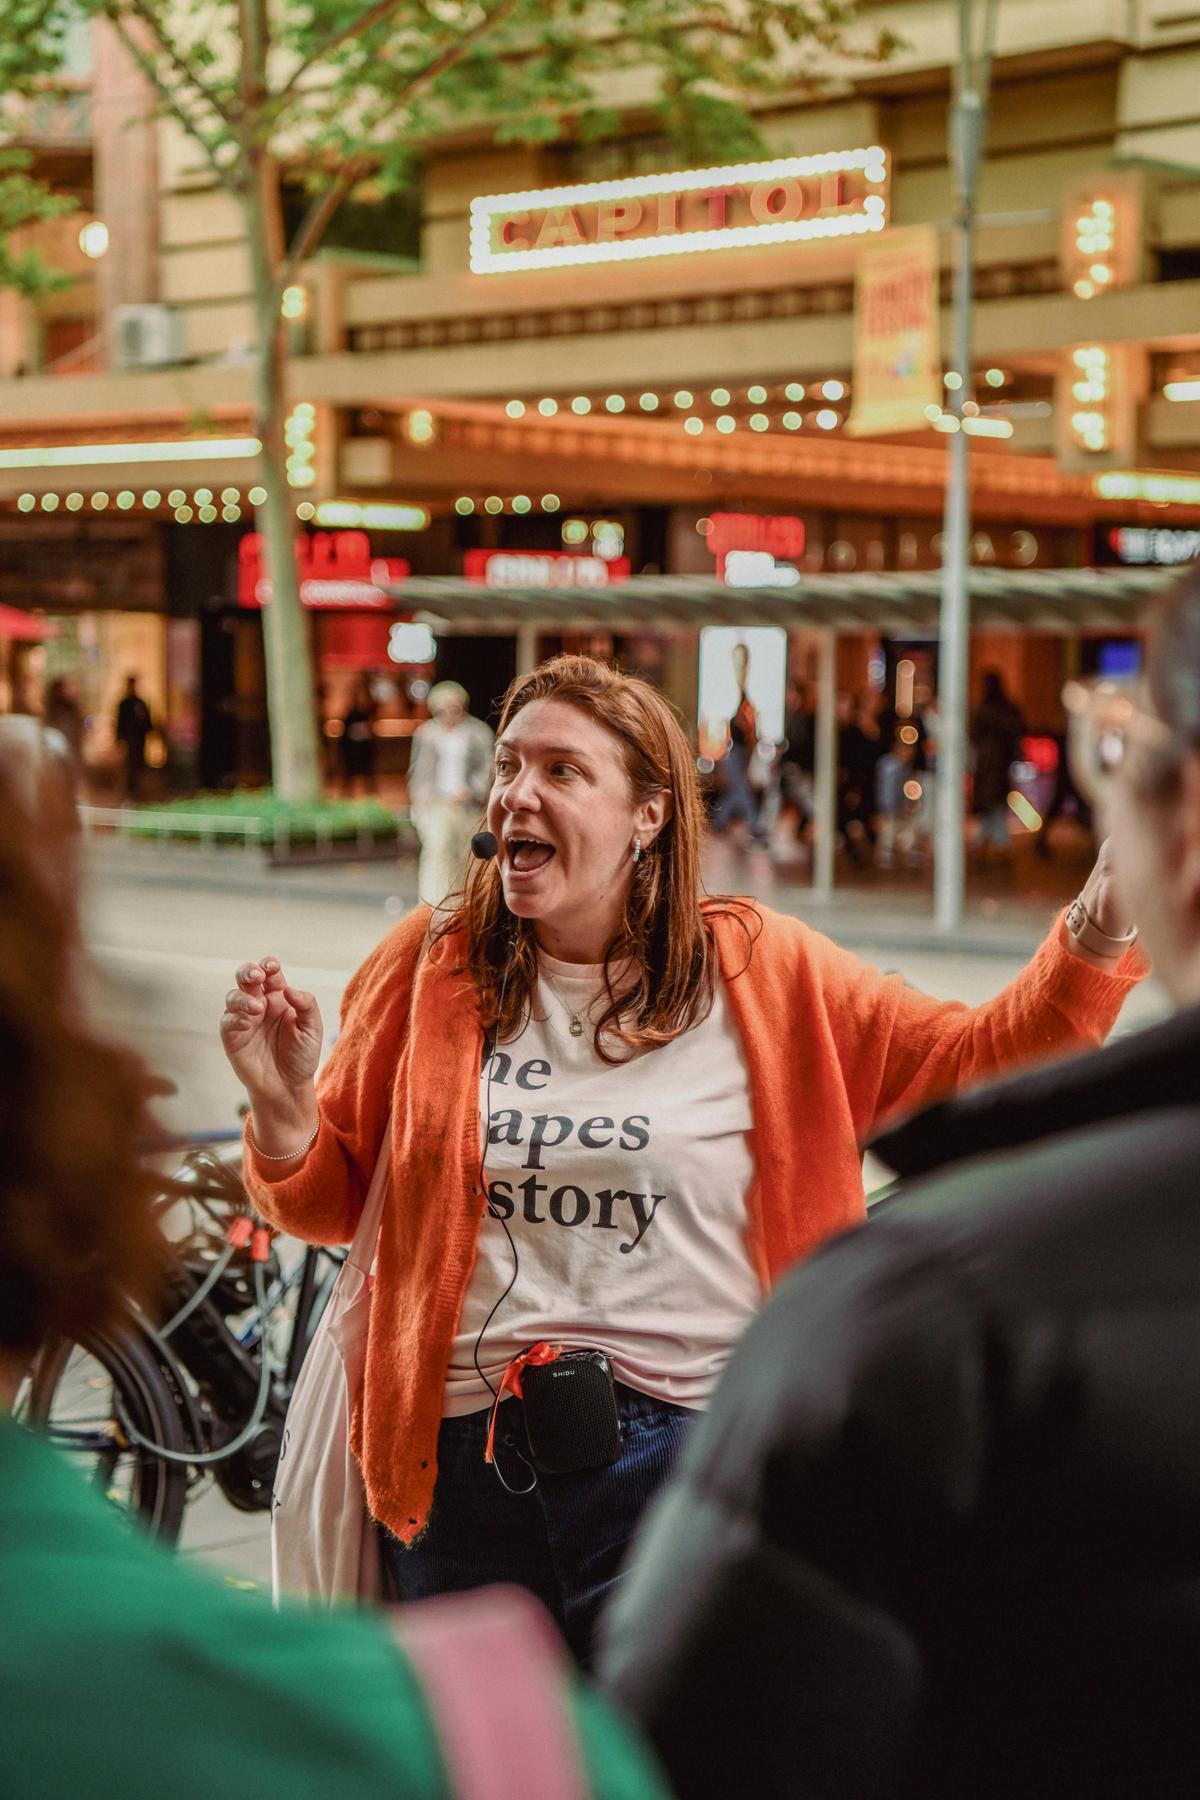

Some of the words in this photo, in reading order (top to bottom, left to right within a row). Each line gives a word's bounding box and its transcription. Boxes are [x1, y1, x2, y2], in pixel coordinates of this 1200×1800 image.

[501, 172, 865, 251] CAPITOL
[486, 1109, 651, 1170] apes
[486, 1174, 667, 1254] story
